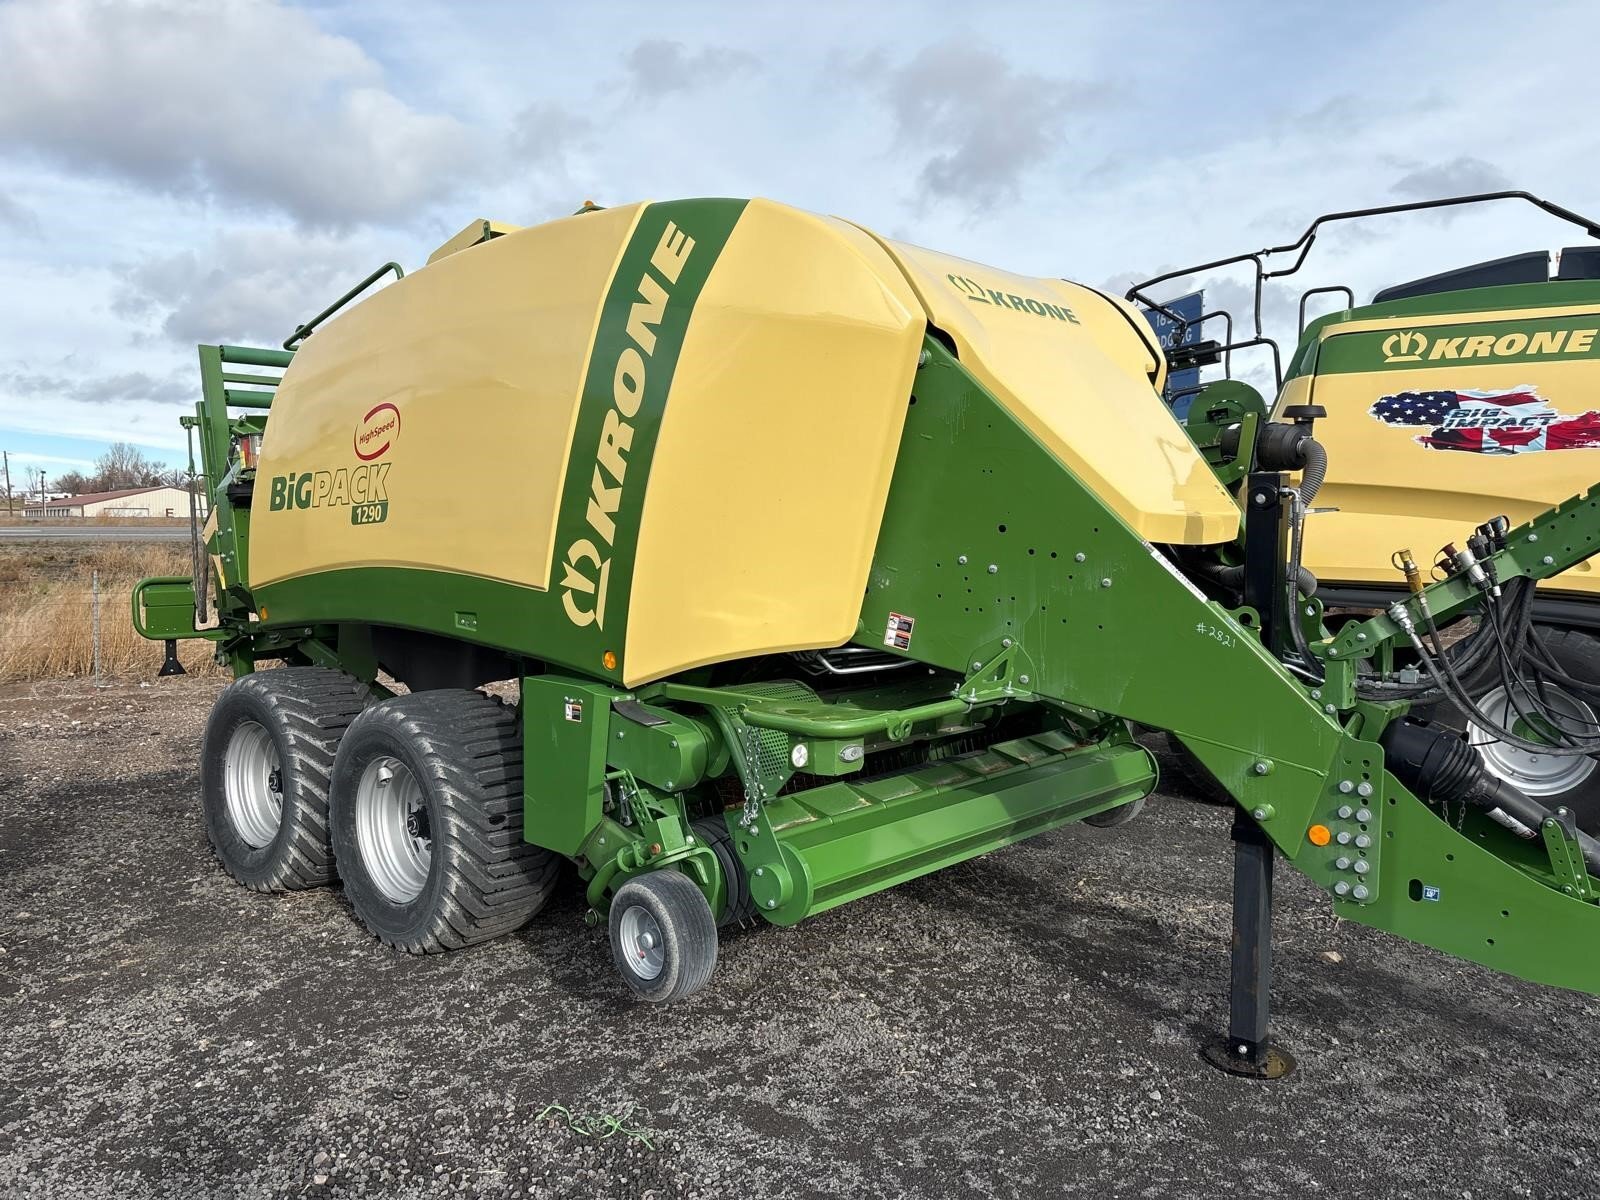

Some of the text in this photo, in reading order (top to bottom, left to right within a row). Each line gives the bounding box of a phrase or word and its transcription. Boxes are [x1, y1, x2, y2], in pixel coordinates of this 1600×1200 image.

[985, 288, 1081, 325] KRONE
[1427, 329, 1599, 361] KRONE
[585, 220, 696, 547] KRONE
[359, 417, 395, 445] HighSpeed
[356, 505, 382, 523] 1290
[1195, 621, 1236, 649] #2821
